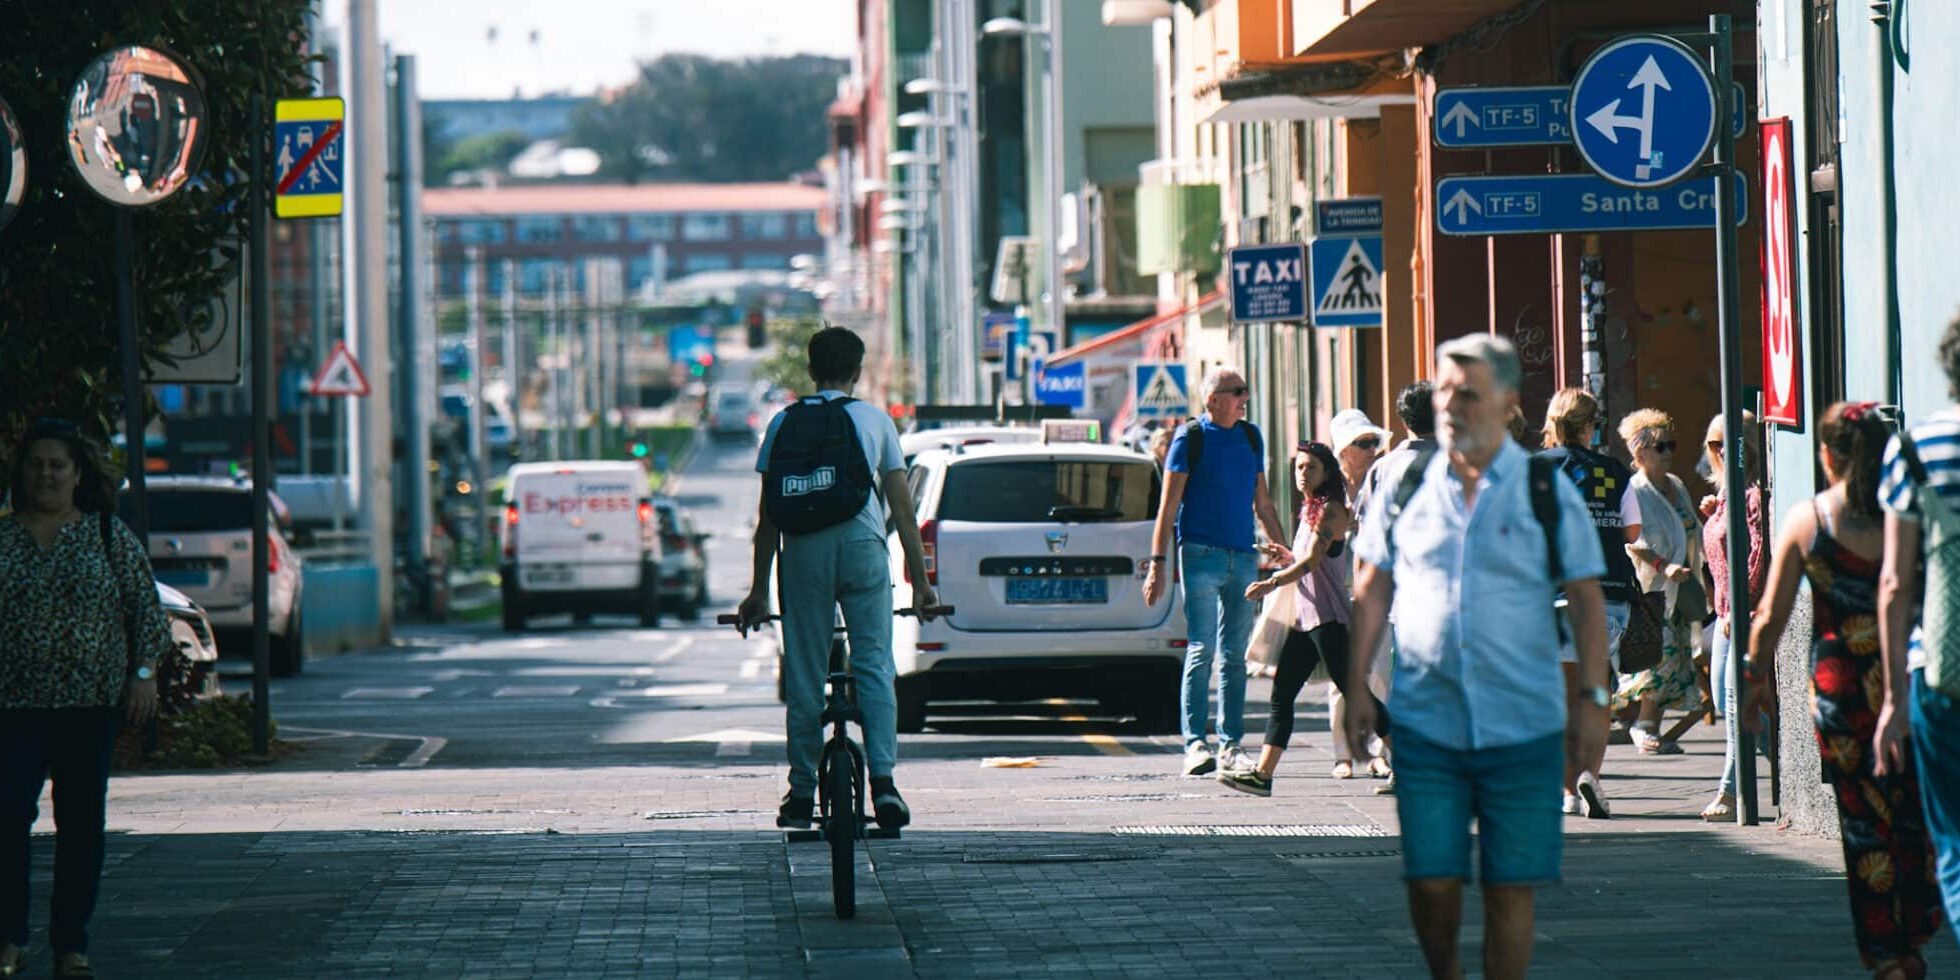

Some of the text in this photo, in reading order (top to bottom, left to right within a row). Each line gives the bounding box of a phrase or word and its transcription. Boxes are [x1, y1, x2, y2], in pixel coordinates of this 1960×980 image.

[1488, 108, 1535, 125] TF-5
[1489, 196, 1537, 213] TF-5
[1581, 190, 1660, 213] Santa
[1233, 258, 1301, 286] TAXI
[1041, 374, 1083, 392] TAXI
[786, 470, 832, 493] PUMA
[523, 492, 633, 516] Express
